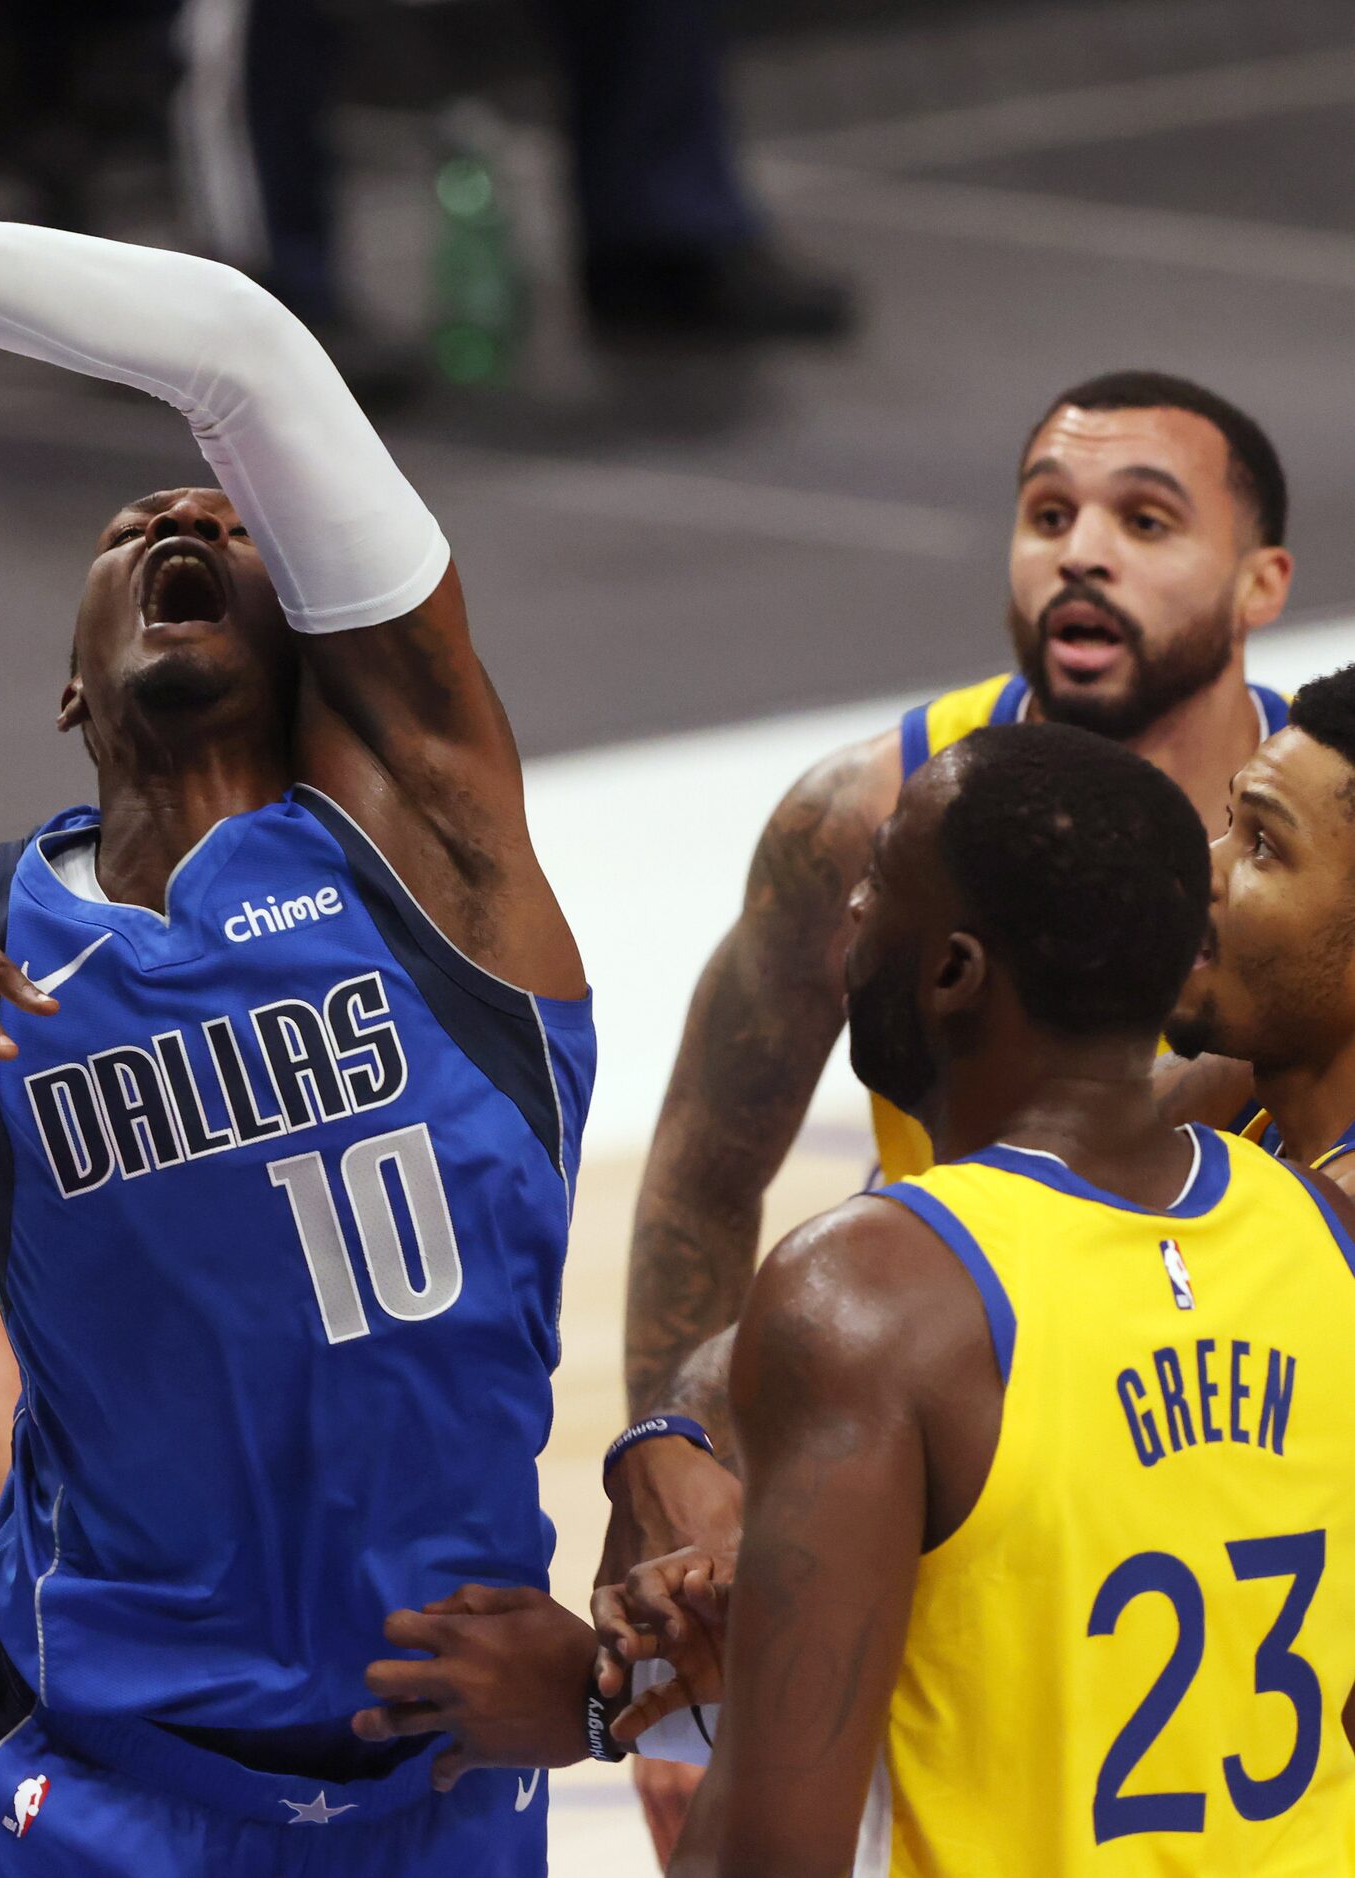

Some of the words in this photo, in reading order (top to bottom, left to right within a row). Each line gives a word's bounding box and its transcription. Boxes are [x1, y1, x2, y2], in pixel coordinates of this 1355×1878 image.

[224, 886, 343, 943] chime
[23, 970, 408, 1199] DALLAS
[266, 1122, 463, 1345] 10
[1116, 1338, 1297, 1467] GREEN
[588, 1697, 606, 1759] Hungry
[1086, 1528, 1327, 1846] 23
